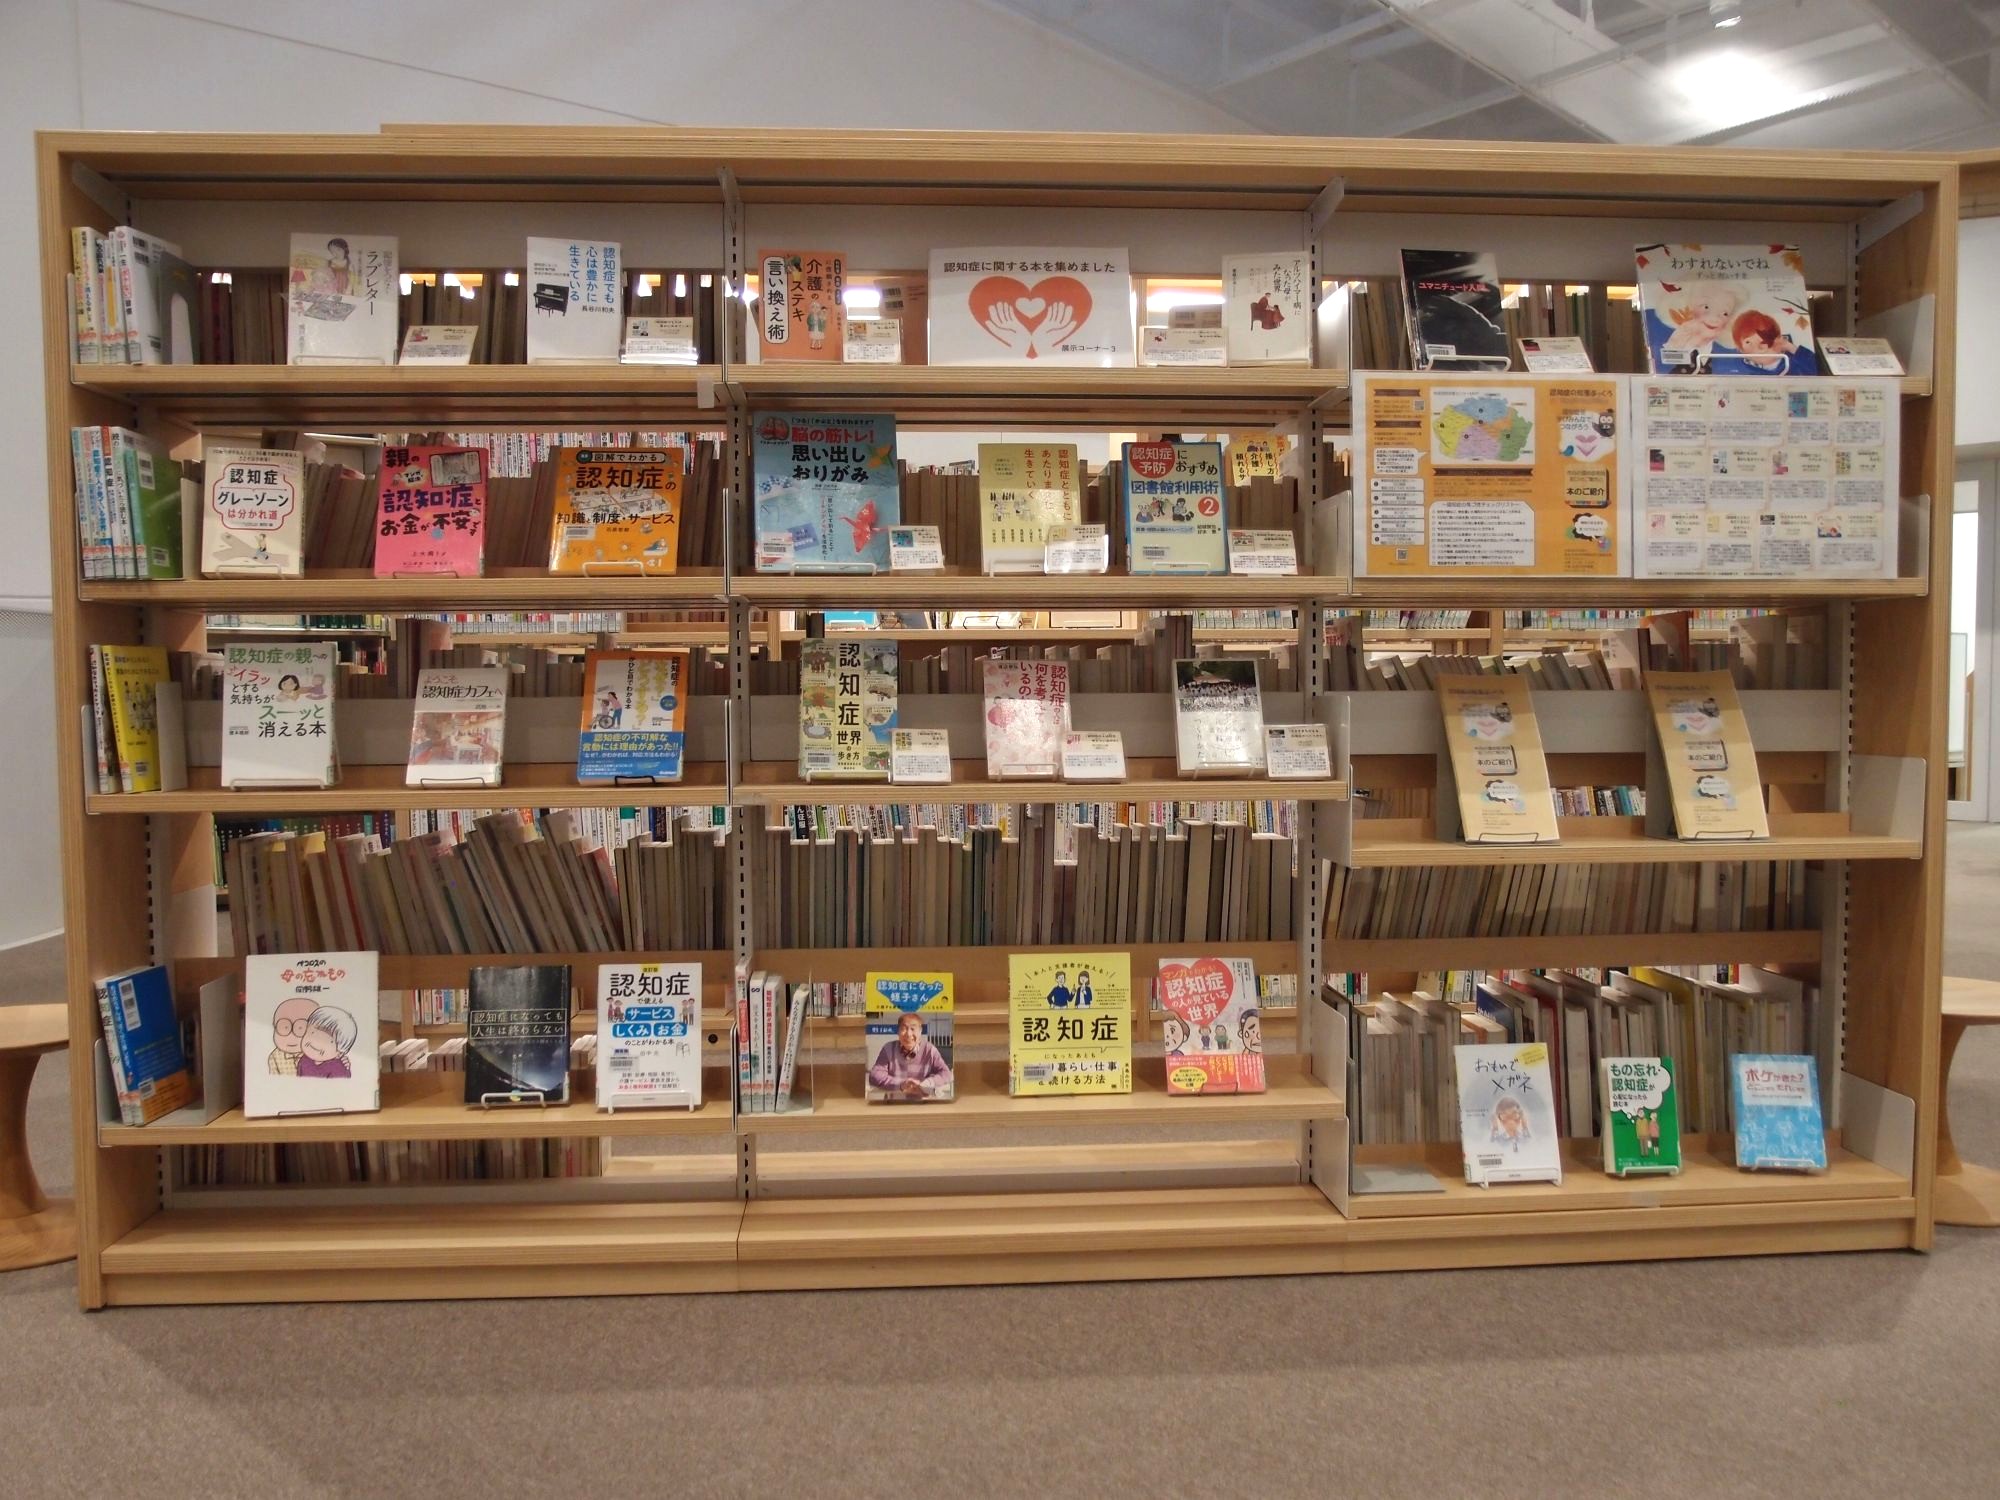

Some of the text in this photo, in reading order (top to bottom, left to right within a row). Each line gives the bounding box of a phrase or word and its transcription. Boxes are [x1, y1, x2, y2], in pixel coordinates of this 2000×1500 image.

[943, 261, 1116, 273] 認知症に関する本を集めました
[1671, 256, 1770, 271] わすれないでね
[569, 245, 581, 302] 生きている
[585, 246, 598, 303] 心は豊かに
[602, 247, 615, 304] 認知症でも
[807, 259, 822, 300] 介護の
[1273, 263, 1282, 293] みた世界
[366, 251, 382, 316] ラブレター
[767, 260, 785, 341] 言い換え術
[791, 280, 805, 322] ステキ
[386, 449, 420, 468] 親の
[594, 454, 657, 462] 図解でわかる
[791, 445, 866, 463] 思い出し
[1132, 447, 1173, 460] 認知症
[792, 465, 869, 483] おりがみ
[1024, 448, 1036, 500] 生きていく
[1139, 461, 1166, 474] 予防
[1175, 460, 1218, 477] おすすめ
[230, 468, 278, 485] 認知症
[576, 467, 676, 490] 認知症の
[1131, 481, 1219, 495] 図書館利用術
[1566, 487, 1605, 496] 本のご紹介
[218, 491, 289, 507] グレーゾーン
[382, 484, 482, 513] 認知症と
[1203, 498, 1215, 514] 2
[228, 509, 278, 520] は分かれ道
[557, 512, 675, 524] 知識と制度・サービス
[229, 647, 328, 664] 認知症の親への
[234, 668, 271, 686] イラッ
[837, 643, 861, 726] 認知症
[1019, 661, 1032, 700] いるの
[232, 684, 260, 693] とする
[422, 685, 504, 698] 認知症カフェへ
[230, 694, 275, 705] 気持ちが
[259, 704, 325, 720] スーッと
[258, 721, 327, 738] 消える本
[837, 730, 862, 745] 世界
[837, 752, 861, 760] 歩き方
[281, 968, 346, 983] 母の忘れもの
[610, 972, 690, 997] 認知症
[877, 980, 943, 991] 認知症になった
[1165, 971, 1227, 999] 認知症
[1172, 990, 1229, 1008] の人が見ている
[474, 1011, 563, 1024] 認知症になっても
[627, 1008, 673, 1020] サービス
[1187, 1002, 1219, 1021] 世界
[474, 1025, 563, 1037] 人生は終わらない
[616, 1024, 685, 1036] しくみ お金
[1022, 1014, 1119, 1042] 認知症
[1051, 1061, 1118, 1072] 暮らし・仕事
[1475, 1058, 1519, 1073] おもいで
[1491, 1072, 1533, 1095] メガネ
[1612, 1078, 1656, 1092] 認知症が
